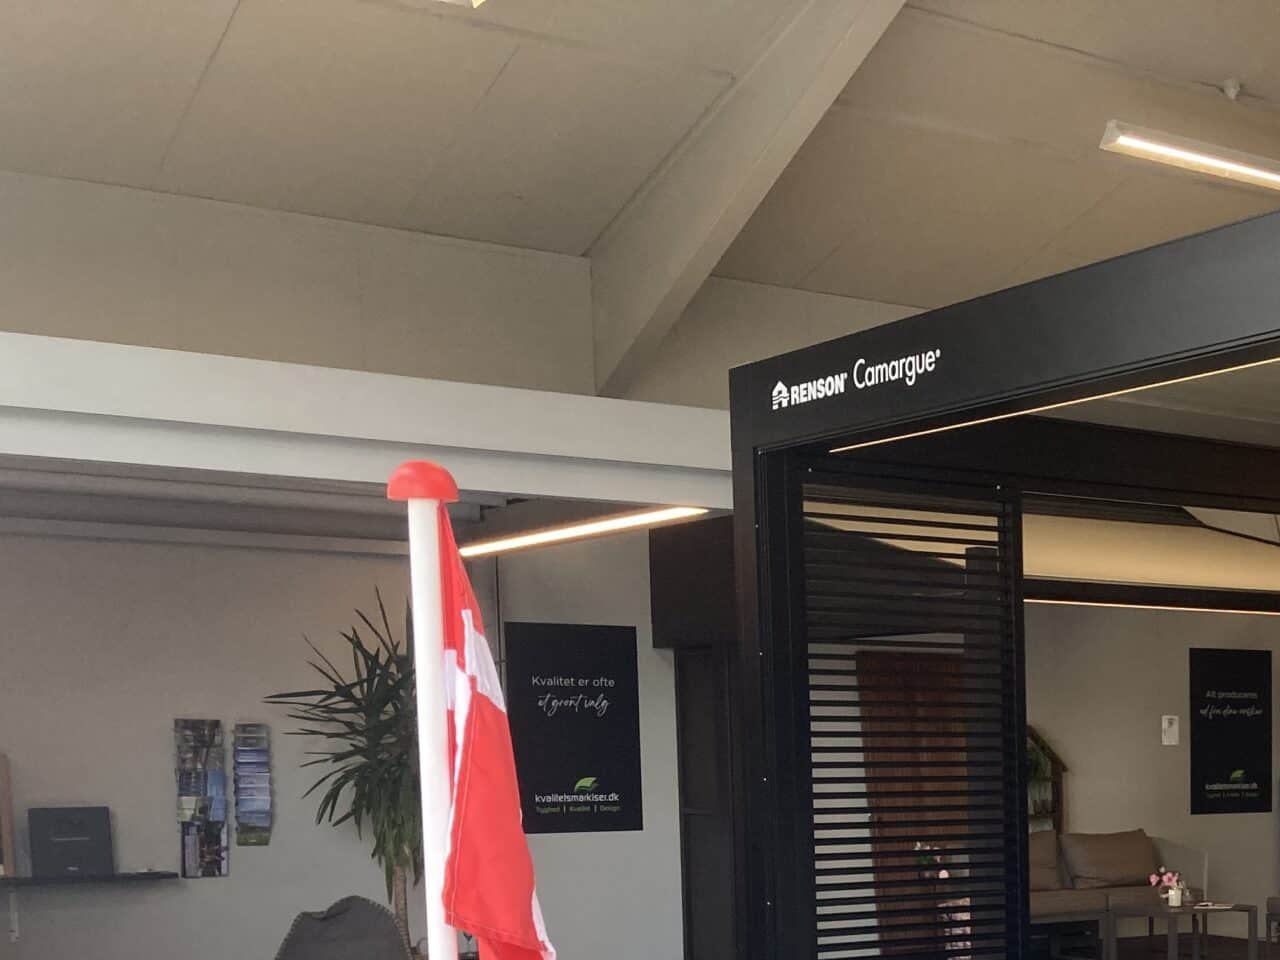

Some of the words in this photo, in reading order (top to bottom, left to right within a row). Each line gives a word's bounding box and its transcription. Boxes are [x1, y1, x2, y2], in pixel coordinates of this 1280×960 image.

[532, 676, 576, 687] Kvalitet
[577, 678, 589, 687] er
[592, 677, 615, 688] ofte
